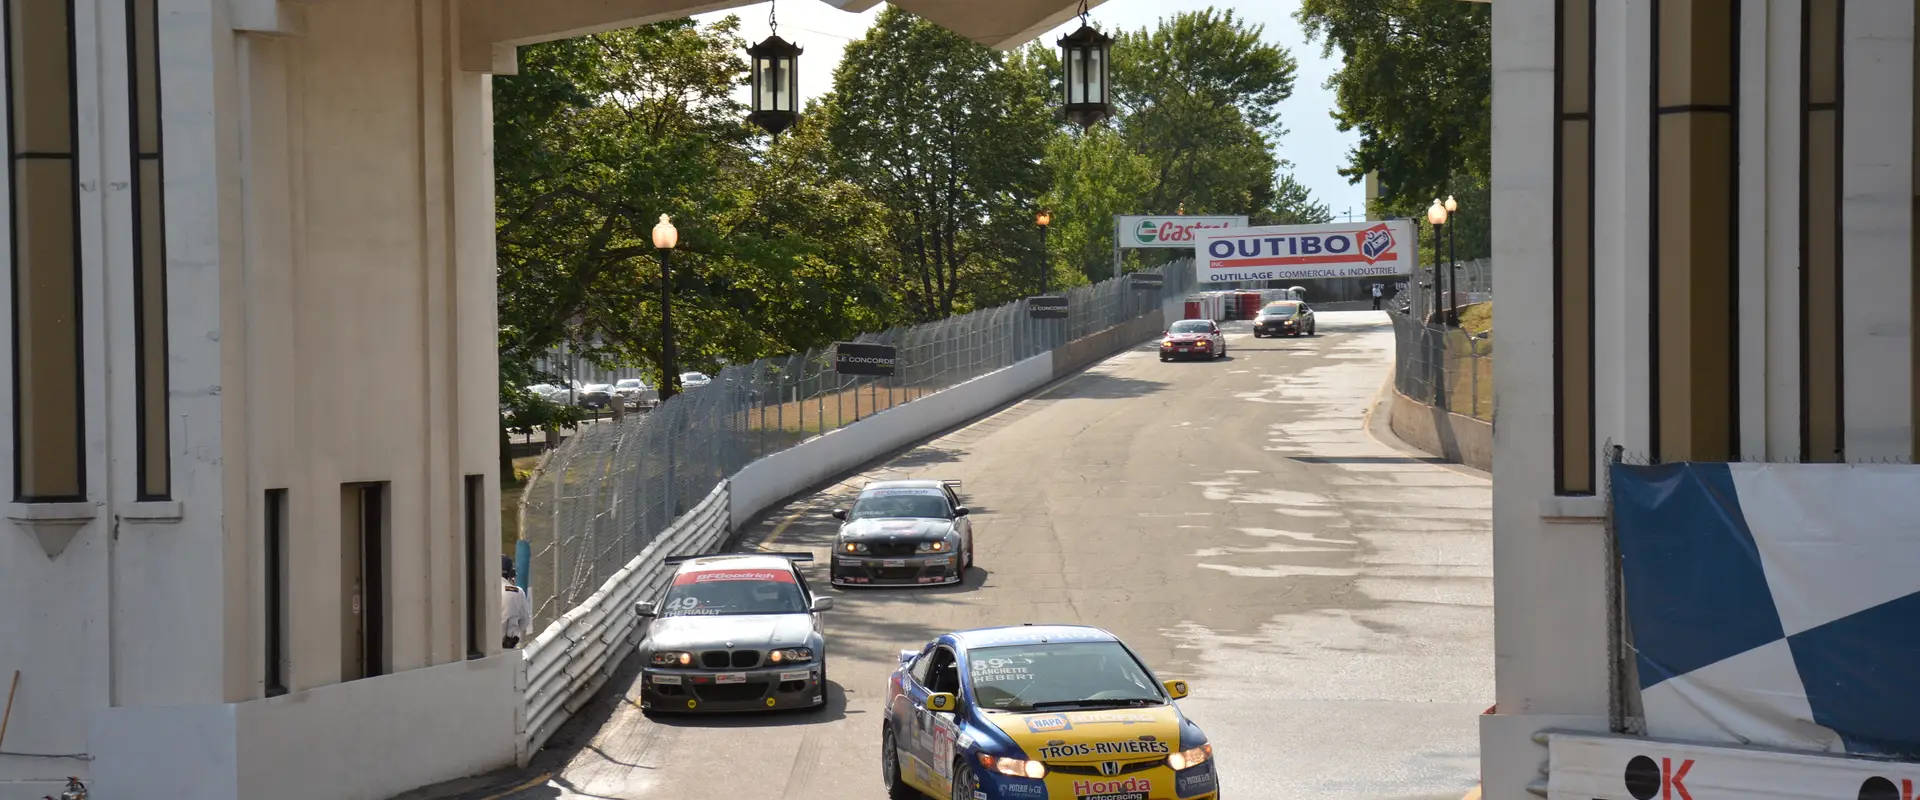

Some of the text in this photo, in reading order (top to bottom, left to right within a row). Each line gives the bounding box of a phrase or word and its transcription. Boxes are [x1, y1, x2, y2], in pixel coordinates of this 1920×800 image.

[1208, 234, 1351, 258] OUTIBO
[1210, 271, 1273, 281] OUTILLAGE
[1279, 269, 1336, 278] COMMERCIAL
[1348, 266, 1397, 275] INDUSTRIEL
[849, 356, 895, 365] CONCORDE
[696, 572, 775, 581] BFGoodrich
[666, 597, 698, 610] 49
[972, 658, 1004, 671] 89
[971, 667, 1028, 677] BLANCHETTE
[1034, 717, 1063, 728] NAPA
[1038, 738, 1170, 760] TROIS-RIVIÈRES
[1073, 777, 1151, 796] Honda
